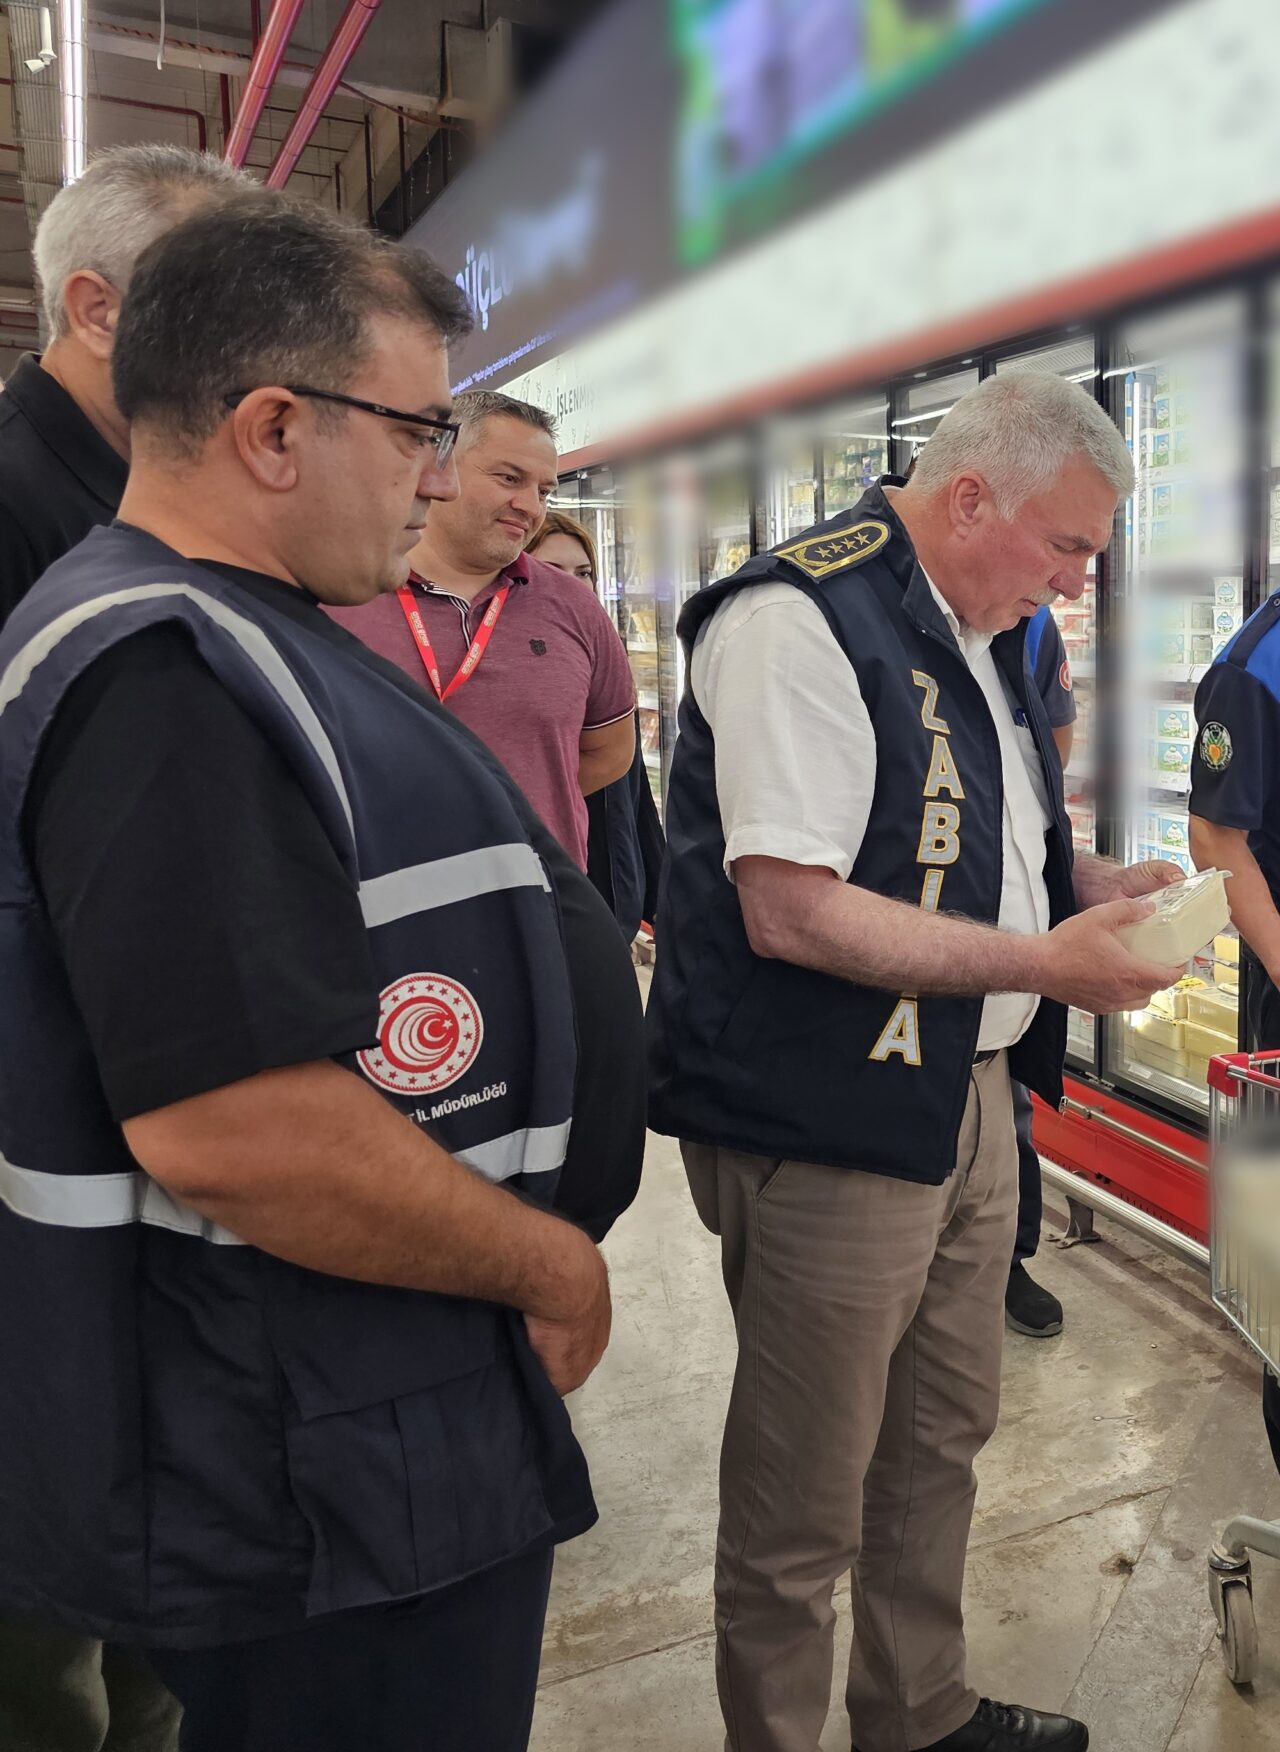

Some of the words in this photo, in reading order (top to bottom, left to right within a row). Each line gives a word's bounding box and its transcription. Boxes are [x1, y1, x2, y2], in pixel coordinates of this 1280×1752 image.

[868, 669, 965, 1066] ZABIA
[415, 1109, 430, 1123] İL
[430, 1081, 507, 1120] MÜDÜRLÜĞÜ
